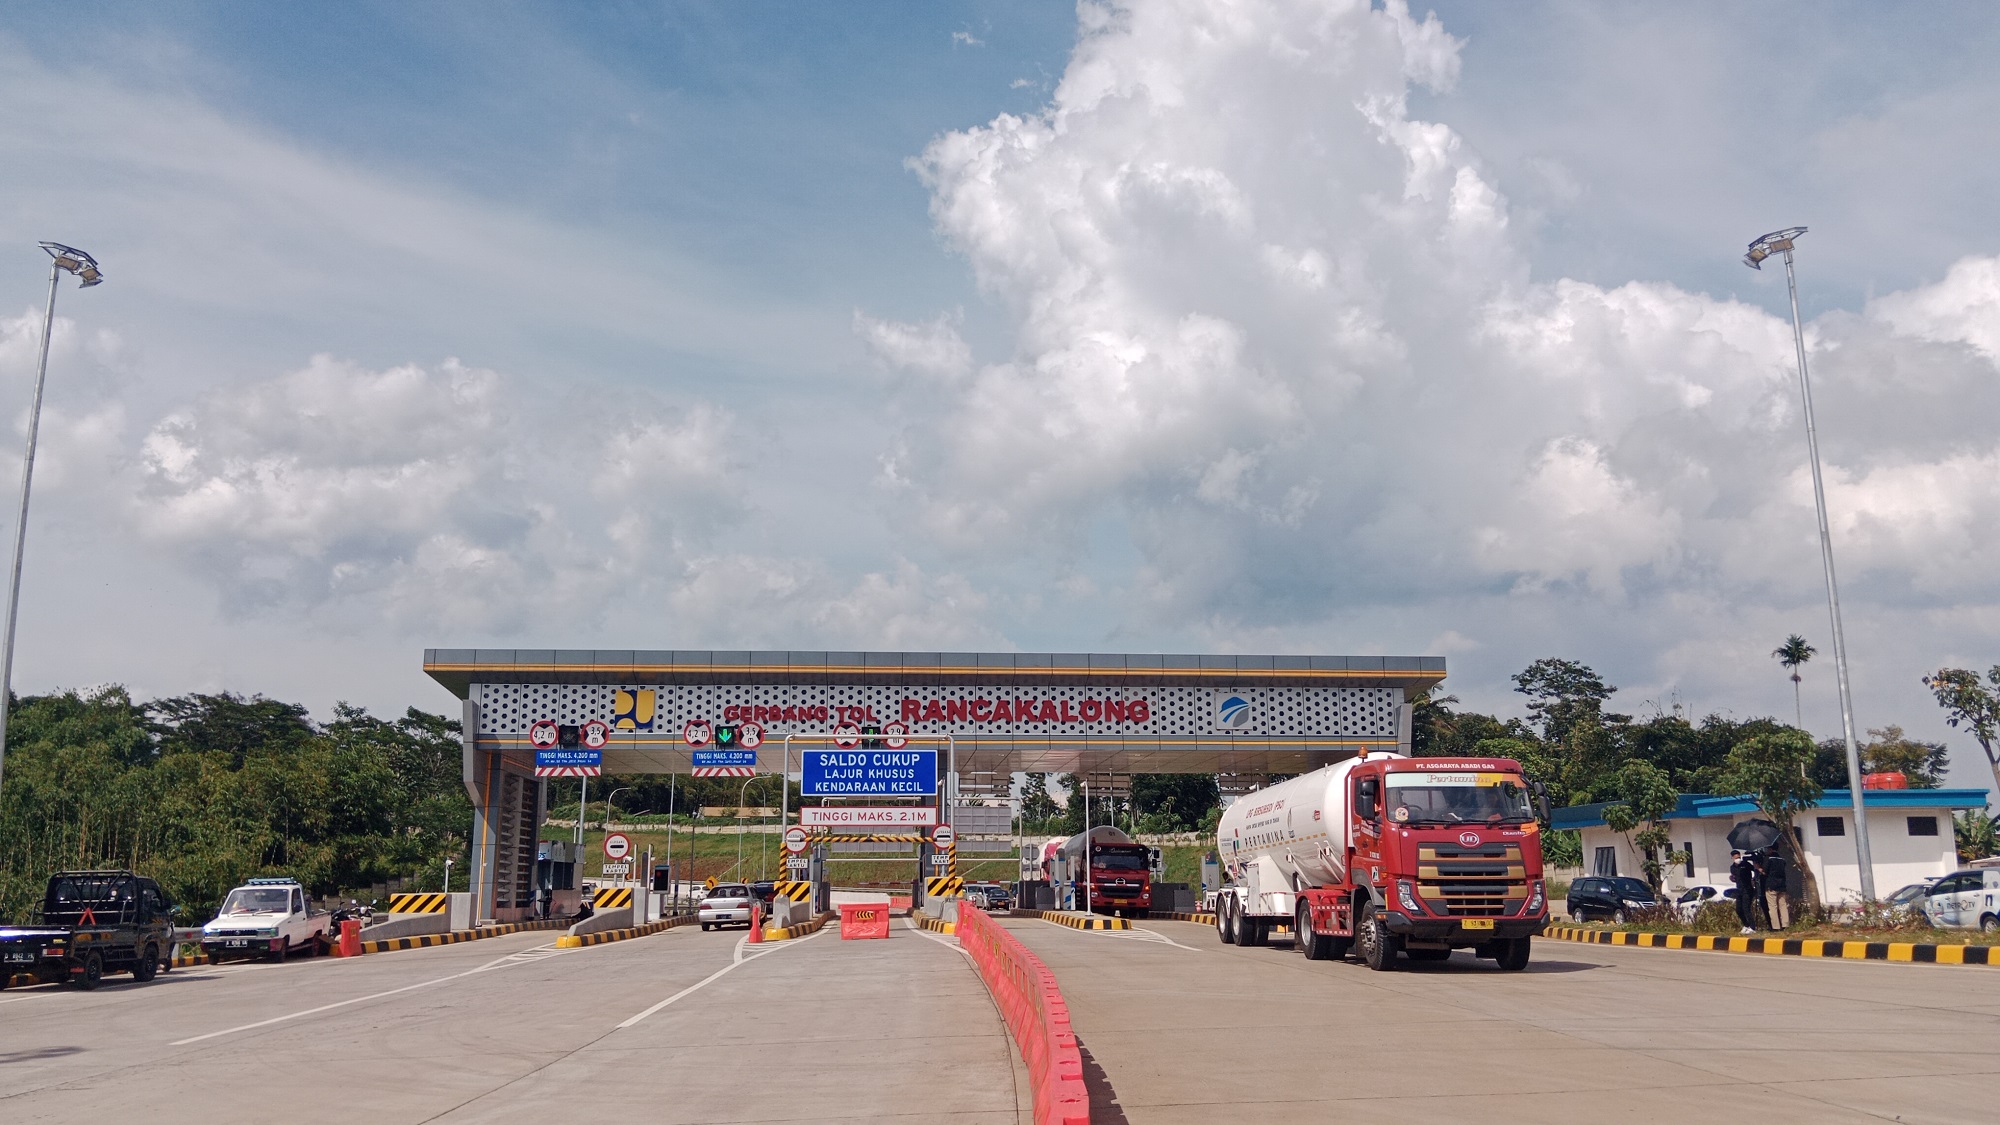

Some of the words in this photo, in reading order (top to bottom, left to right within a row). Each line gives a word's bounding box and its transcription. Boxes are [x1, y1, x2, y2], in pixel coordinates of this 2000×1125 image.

[724, 706, 828, 721] GERBANG
[835, 706, 877, 721] TOL
[901, 699, 1150, 722] RANCAKALONG
[533, 730, 545, 739] 4,2
[590, 726, 601, 735] 3,5
[687, 729, 699, 738] 4,2
[746, 726, 756, 736] 3,5
[819, 753, 867, 766] SALDO
[872, 753, 920, 766] CUKUP
[824, 769, 863, 779] LAJUR
[868, 769, 915, 779] KHUSUS
[815, 782, 886, 792] KENDARAAN
[891, 782, 923, 792] KECIL
[812, 811, 853, 821] TINGGI
[857, 811, 897, 822] MAKS.
[899, 811, 927, 821] 2.1M
[1244, 829, 1285, 848] PERTAMINA
